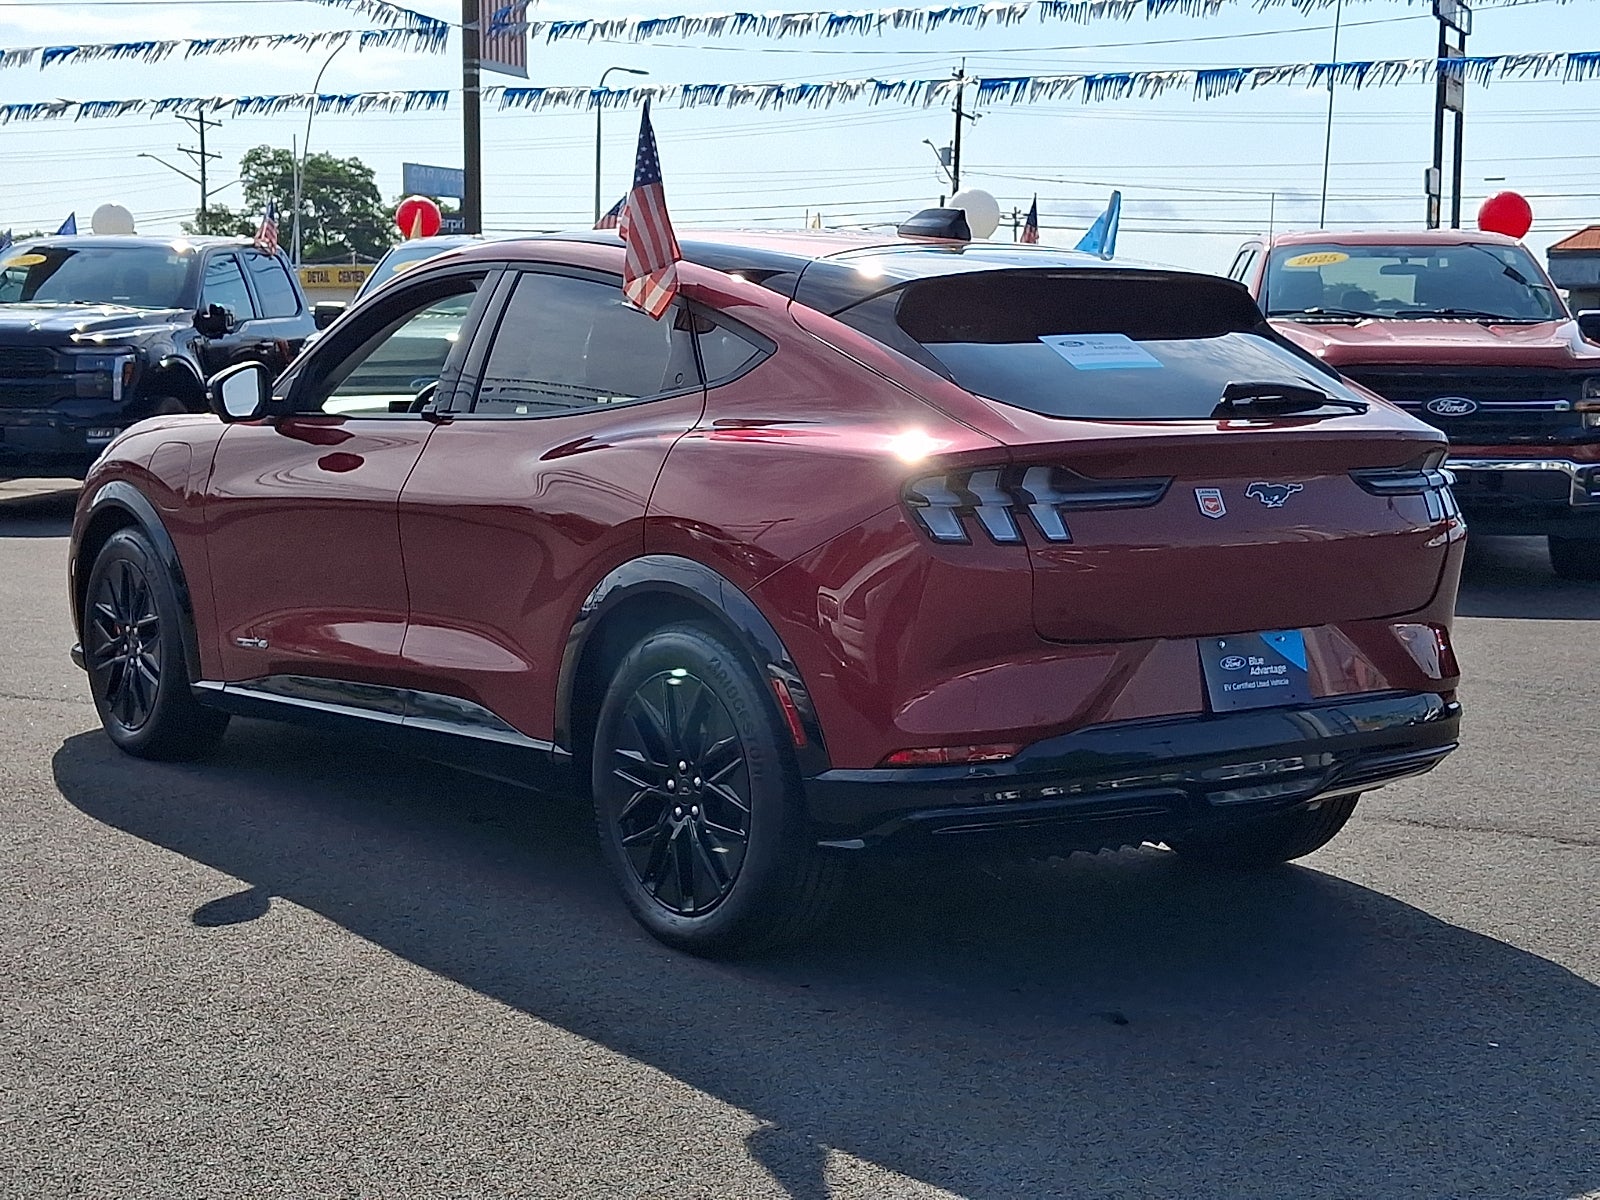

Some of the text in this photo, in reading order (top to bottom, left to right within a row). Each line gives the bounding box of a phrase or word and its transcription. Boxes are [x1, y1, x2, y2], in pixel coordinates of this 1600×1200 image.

[439, 170, 464, 184] WAS
[1298, 254, 1338, 265] 2025
[307, 270, 365, 283] DETAIL CENTER
[1436, 399, 1468, 412] Ford
[1225, 658, 1241, 668] Ford
[1248, 657, 1264, 666] Blue
[1250, 665, 1287, 675] Advantage
[1223, 683, 1232, 691] EV
[1232, 681, 1256, 691] Certified
[1270, 678, 1289, 687] Vehicle
